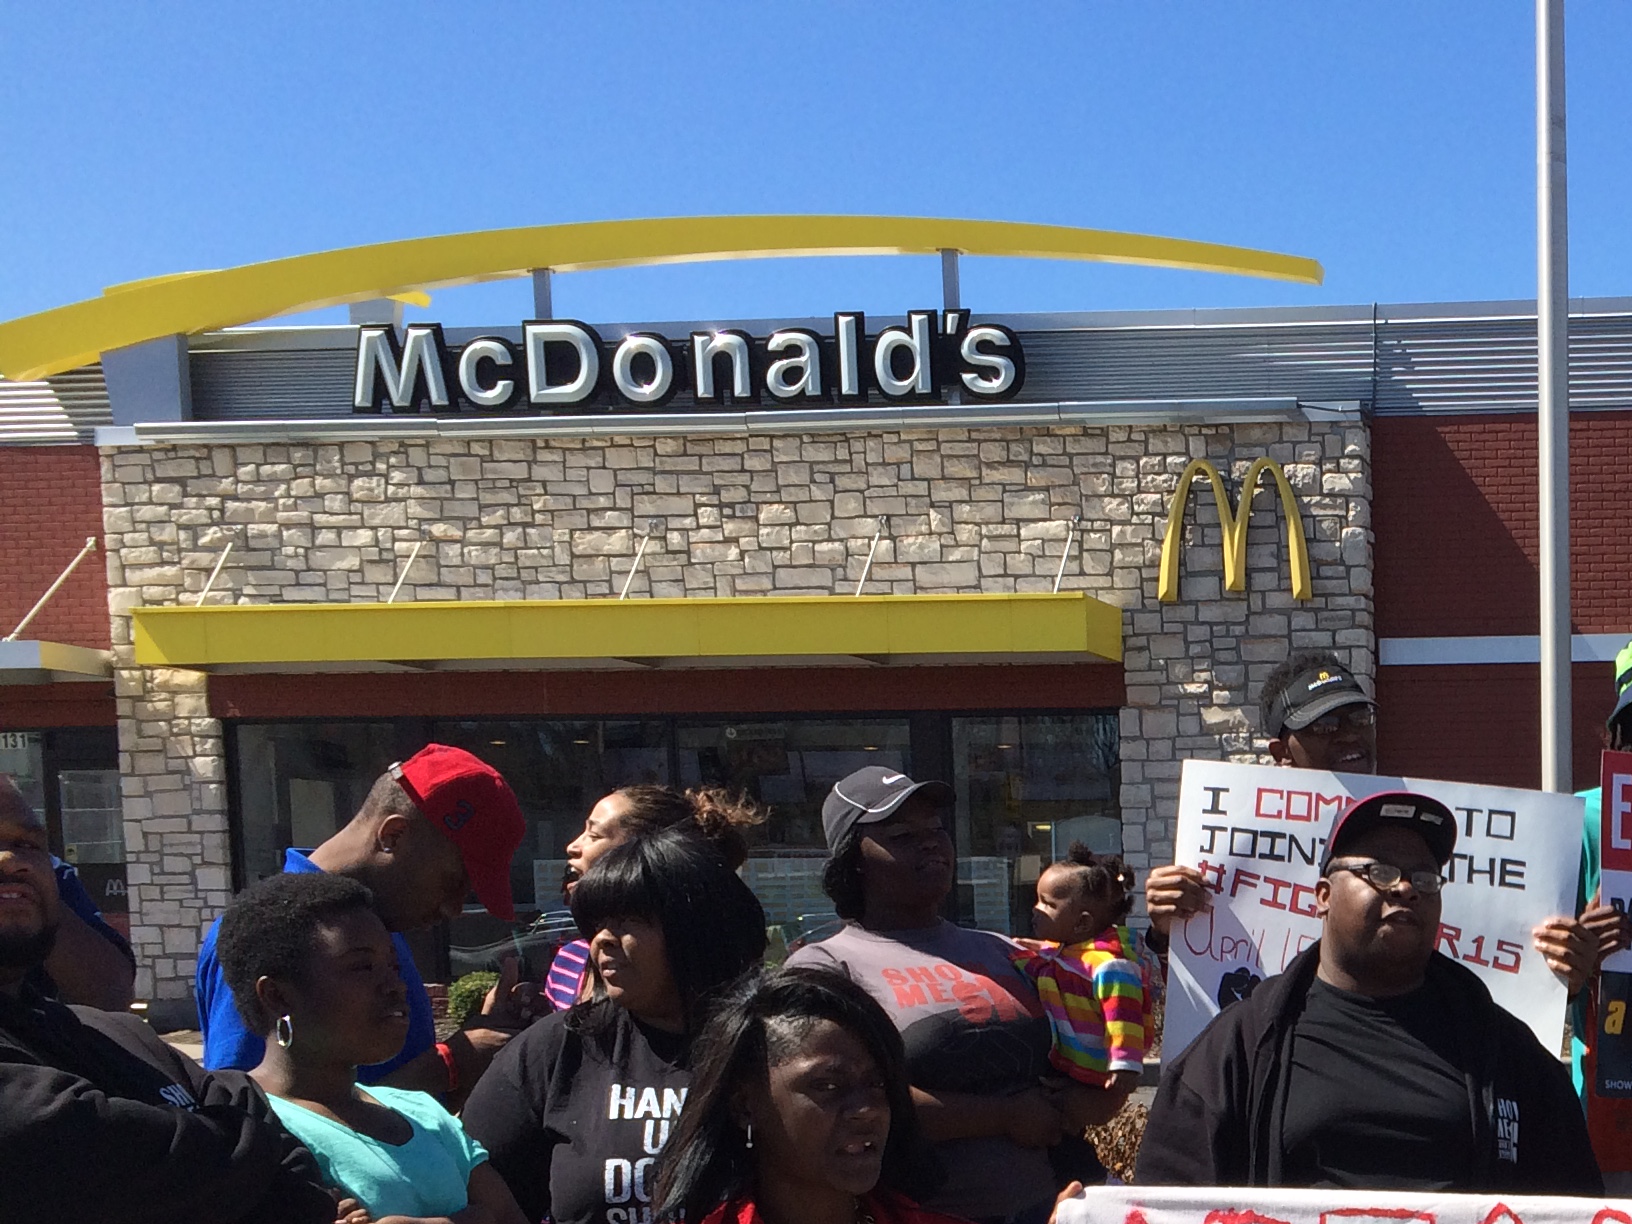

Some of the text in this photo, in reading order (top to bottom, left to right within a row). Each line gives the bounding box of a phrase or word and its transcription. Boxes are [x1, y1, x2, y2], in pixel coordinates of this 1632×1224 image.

[350, 307, 1026, 415] McDonald's
[1202, 787, 1230, 816] I
[1456, 806, 1516, 841] TO
[1604, 999, 1627, 1036] a
